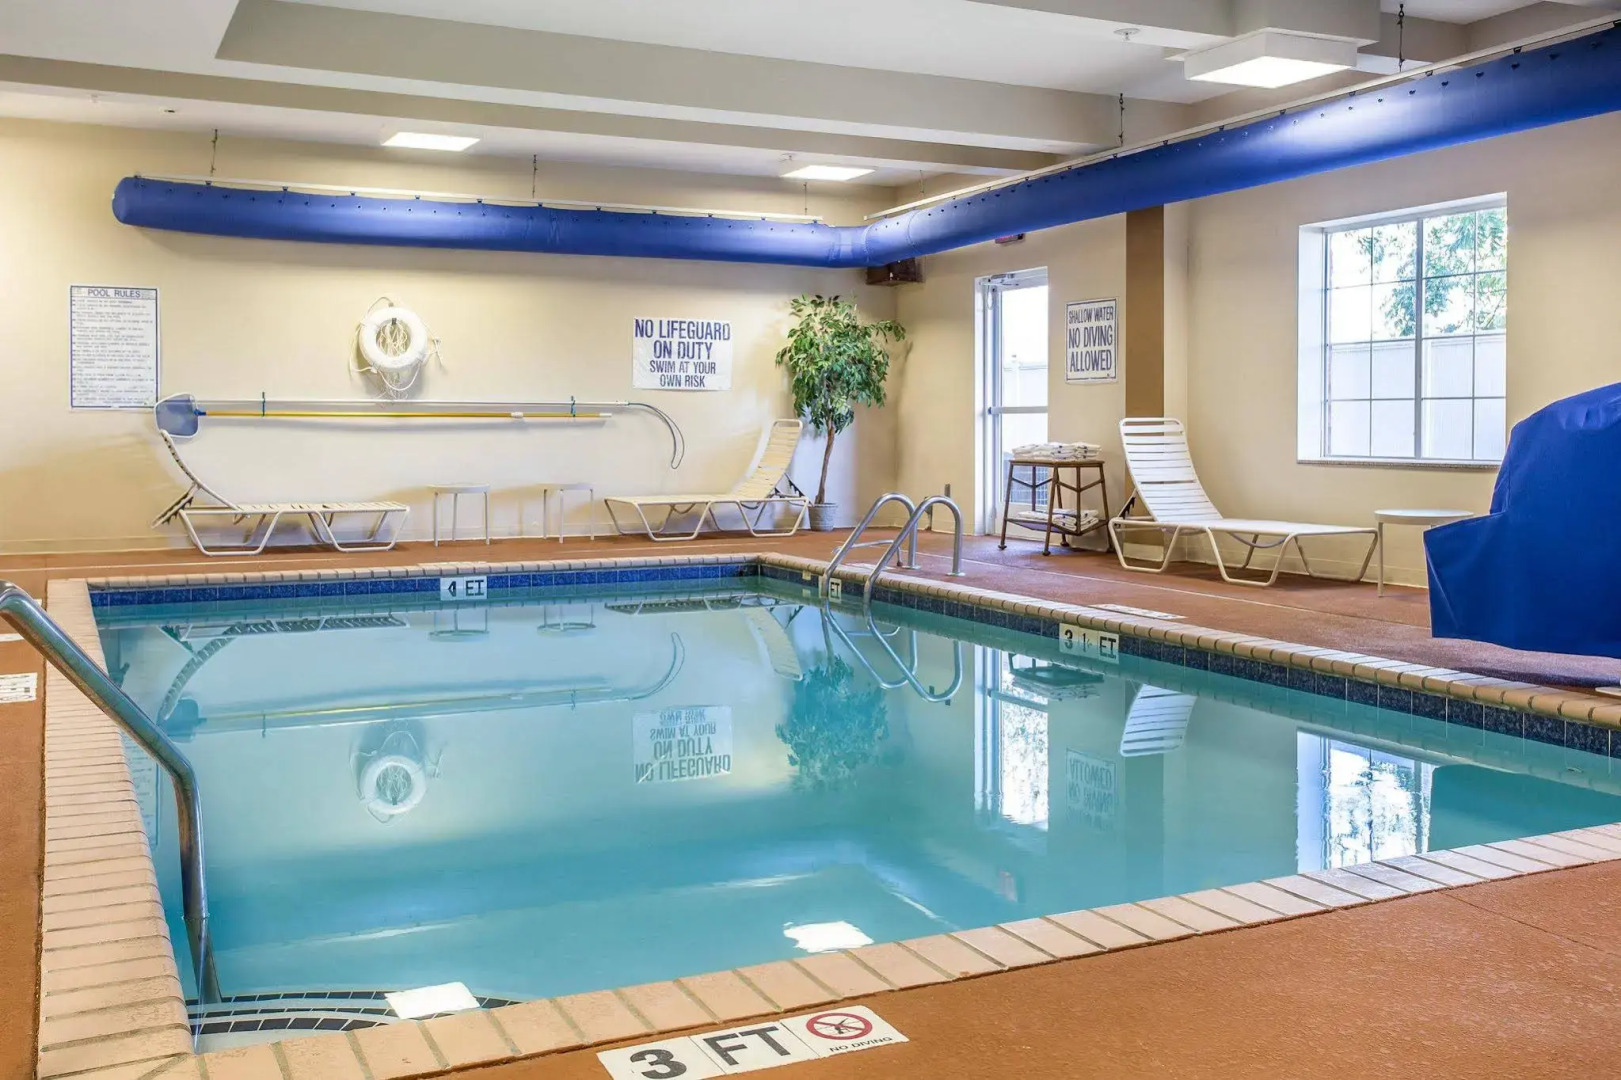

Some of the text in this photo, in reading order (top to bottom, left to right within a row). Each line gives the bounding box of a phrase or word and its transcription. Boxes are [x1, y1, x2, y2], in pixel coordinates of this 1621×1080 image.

[88, 288, 141, 298] POOL RULES
[1068, 306, 1114, 324] SHALLOW WATER
[635, 319, 731, 340] NO LIFEGUARD
[1069, 325, 1113, 349] NO DIVING
[654, 340, 712, 360] ON DUTY
[650, 360, 716, 374] SWIM AT YOUR
[1070, 349, 1112, 372] ALLOWED
[660, 374, 705, 387] OWN RISK
[851, 1036, 893, 1048] DIVING
[630, 1025, 792, 1080] 3 FT
